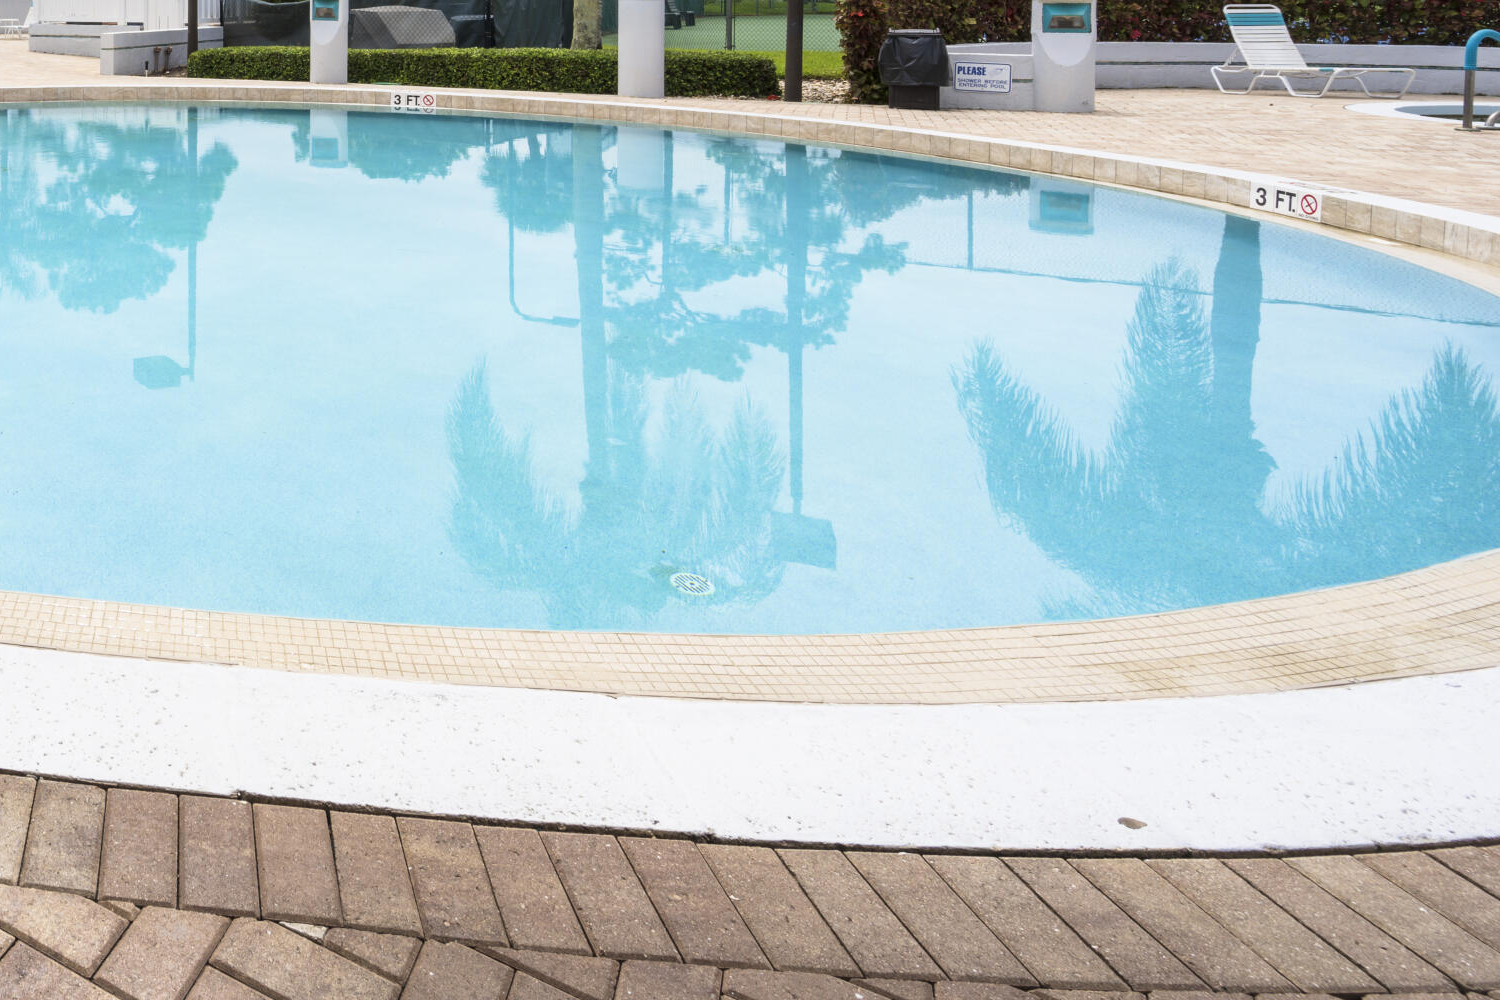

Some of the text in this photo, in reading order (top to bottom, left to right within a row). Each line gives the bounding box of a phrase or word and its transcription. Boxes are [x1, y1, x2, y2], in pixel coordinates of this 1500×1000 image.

[957, 66, 987, 76] PLEASE
[393, 94, 420, 106] 3 FT.
[1255, 187, 1297, 213] 3 FT.
